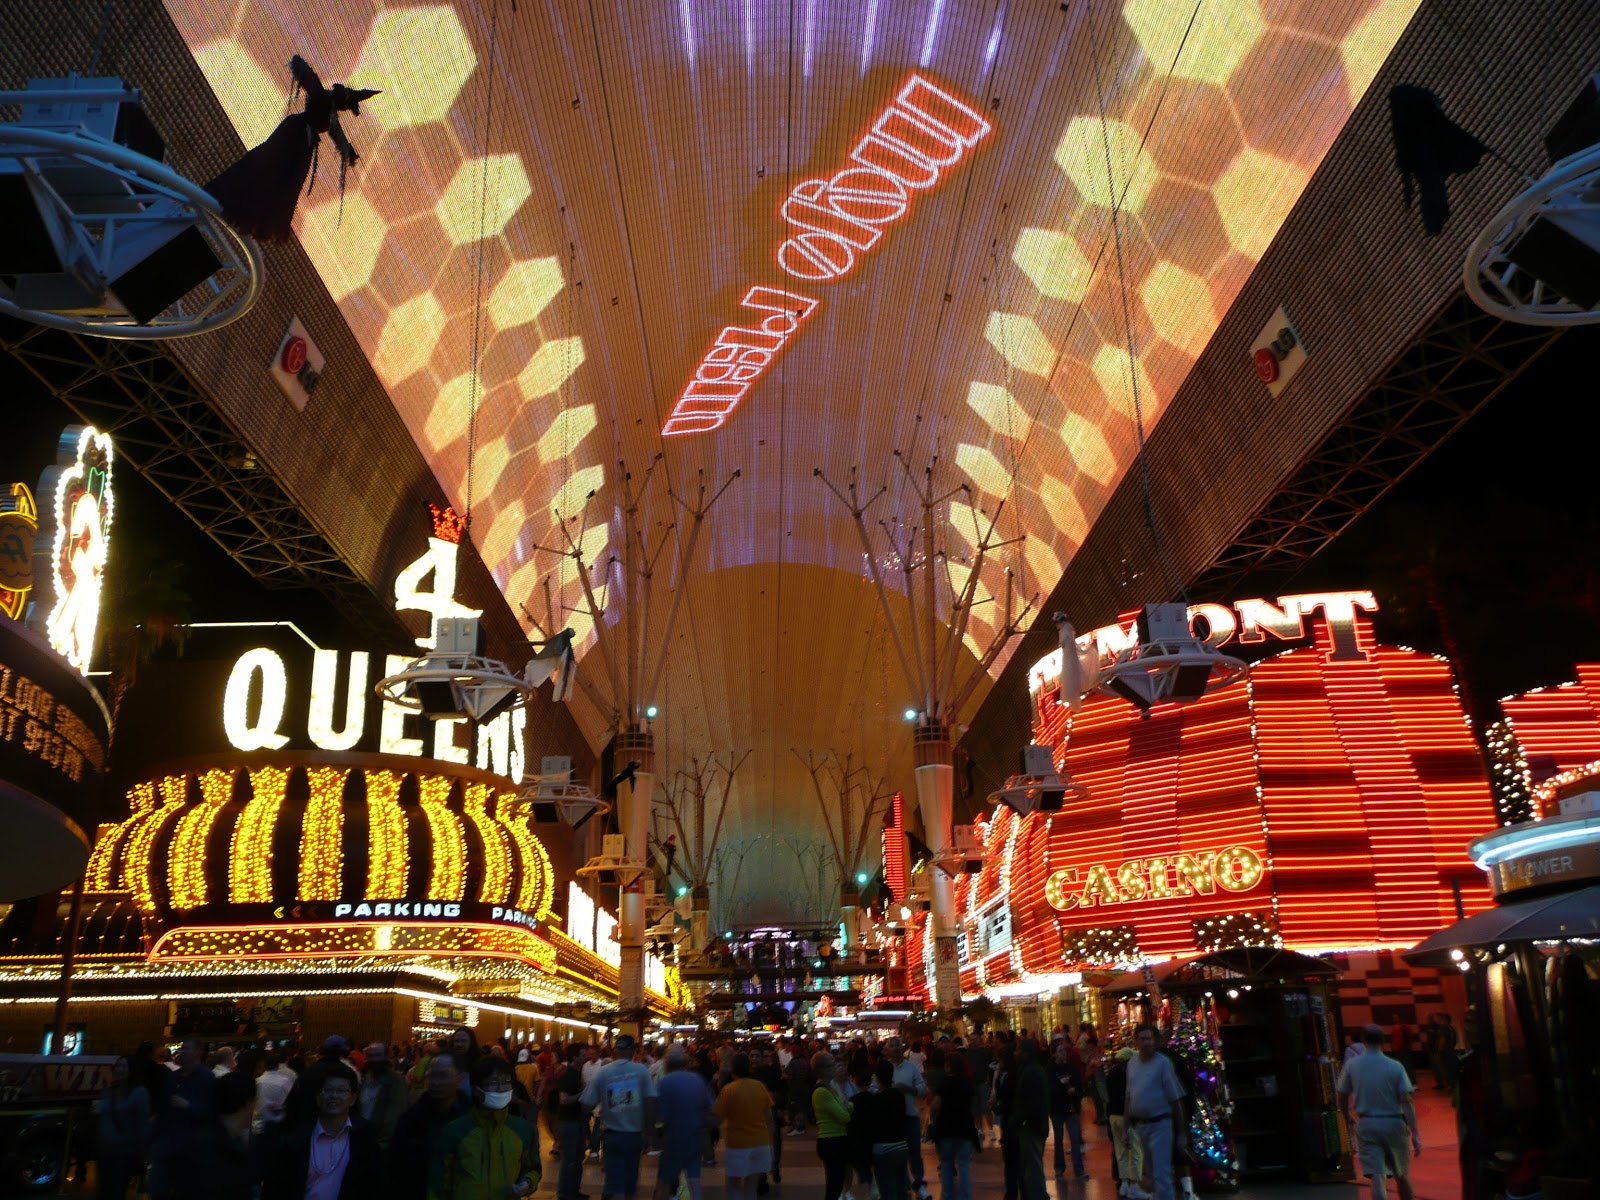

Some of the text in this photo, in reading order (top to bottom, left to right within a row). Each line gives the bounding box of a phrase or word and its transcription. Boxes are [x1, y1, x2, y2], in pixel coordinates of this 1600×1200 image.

[395, 536, 483, 650] 4
[1028, 590, 1378, 735] FRMONT
[335, 902, 461, 918] PARKING
[1045, 846, 1264, 911] CASINO
